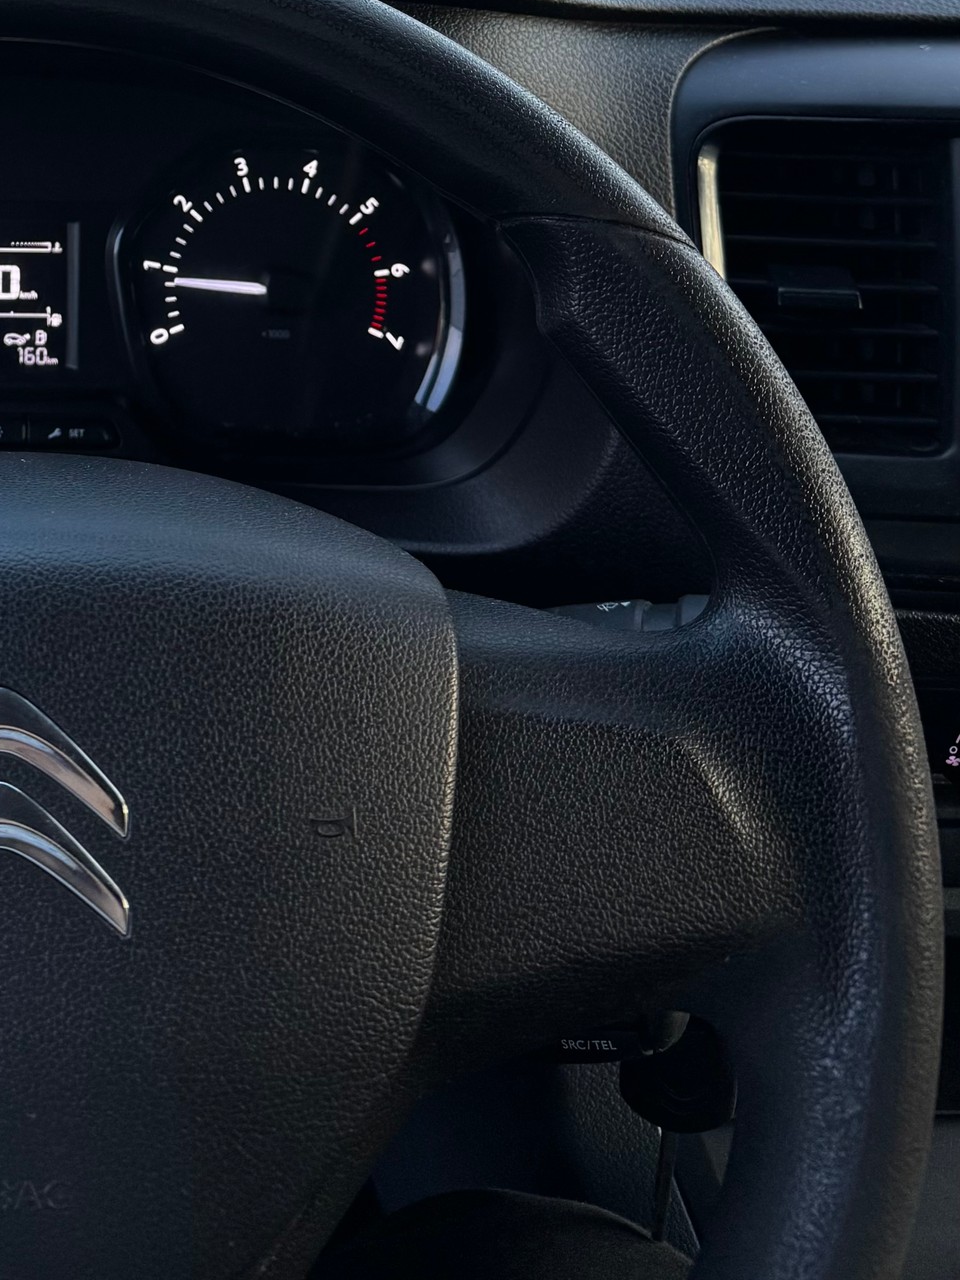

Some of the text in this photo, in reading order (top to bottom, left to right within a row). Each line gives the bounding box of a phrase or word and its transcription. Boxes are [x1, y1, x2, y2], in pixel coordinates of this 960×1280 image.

[234, 157, 249, 177] 3
[303, 159, 318, 178] 4
[173, 194, 193, 213] 2
[359, 196, 380, 216] 5
[143, 260, 162, 271] 1
[390, 262, 411, 279] 6
[149, 327, 169, 345] 0
[385, 331, 405, 351] 7
[560, 1038, 618, 1051] SRC/TEL
